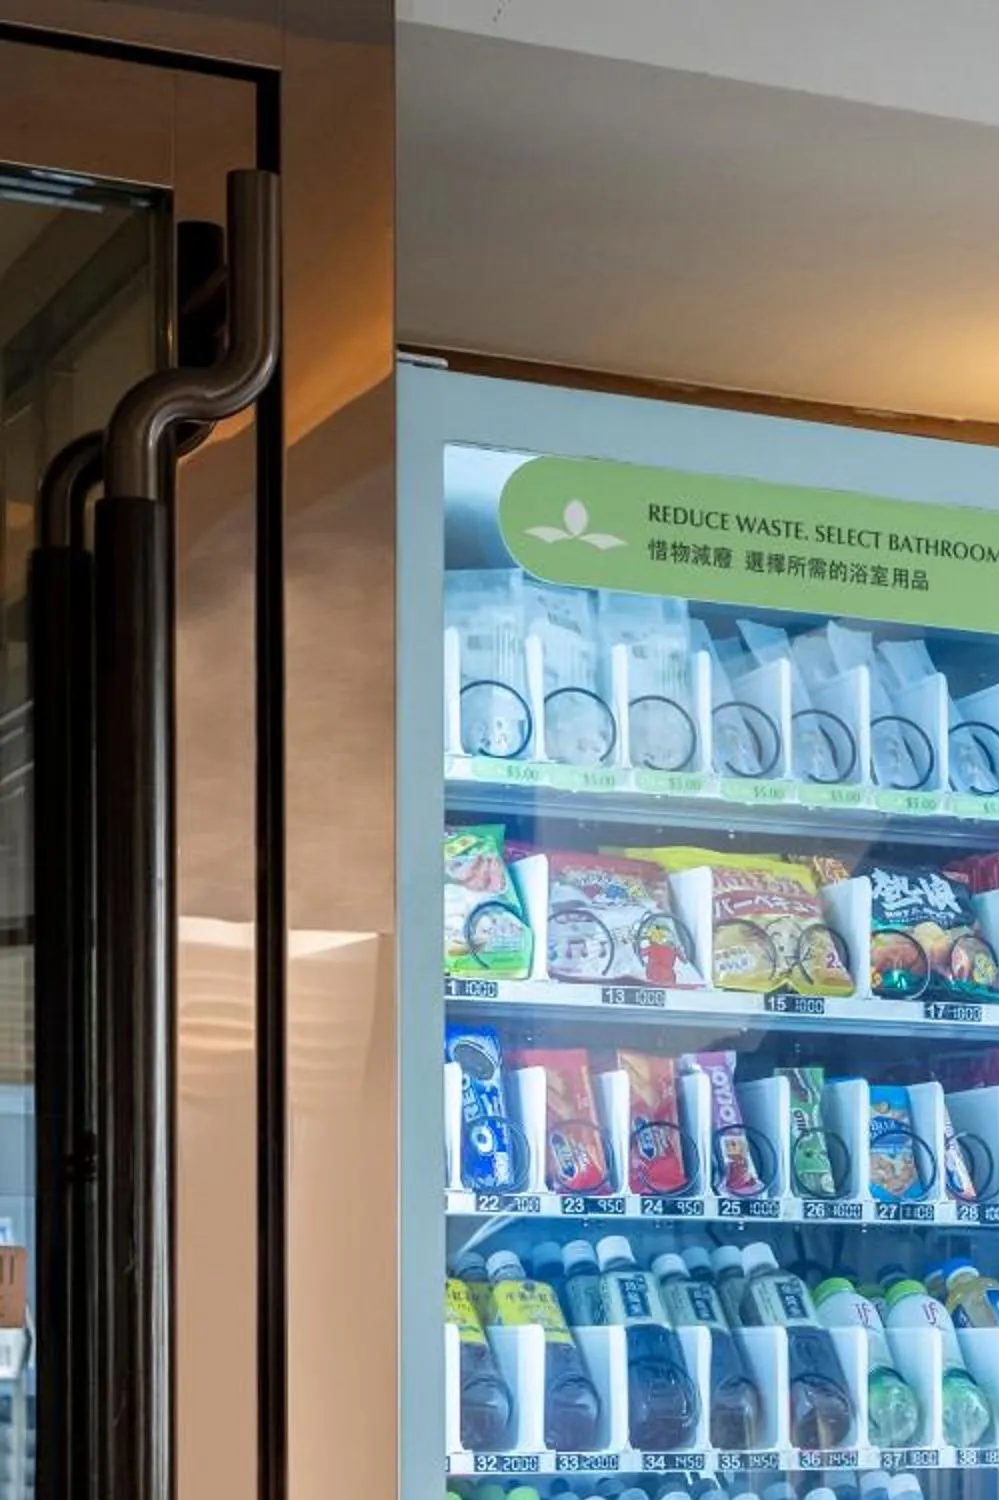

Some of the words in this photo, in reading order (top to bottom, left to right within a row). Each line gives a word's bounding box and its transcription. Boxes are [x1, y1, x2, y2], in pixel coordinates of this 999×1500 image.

[648, 503, 730, 530] REDUCE
[735, 514, 809, 540] WASTE.
[815, 524, 882, 550] SELECT
[648, 538, 733, 569] 惜物減廢
[745, 550, 929, 591] 選擇所需的浴室用品
[605, 990, 624, 1003] 13
[769, 999, 786, 1011] 15
[927, 1005, 944, 1018] 17
[479, 1196, 499, 1210] 22
[564, 1199, 584, 1213] 23
[644, 1201, 663, 1215] 24
[721, 1201, 740, 1215] 25
[806, 1204, 825, 1217] 26
[879, 1204, 898, 1219] 27
[477, 1456, 497, 1471] 32
[559, 1456, 578, 1470] 33
[646, 1455, 665, 1469] 34
[721, 1455, 740, 1469] 35
[801, 1452, 820, 1466] 36
[883, 1453, 901, 1467] 37
